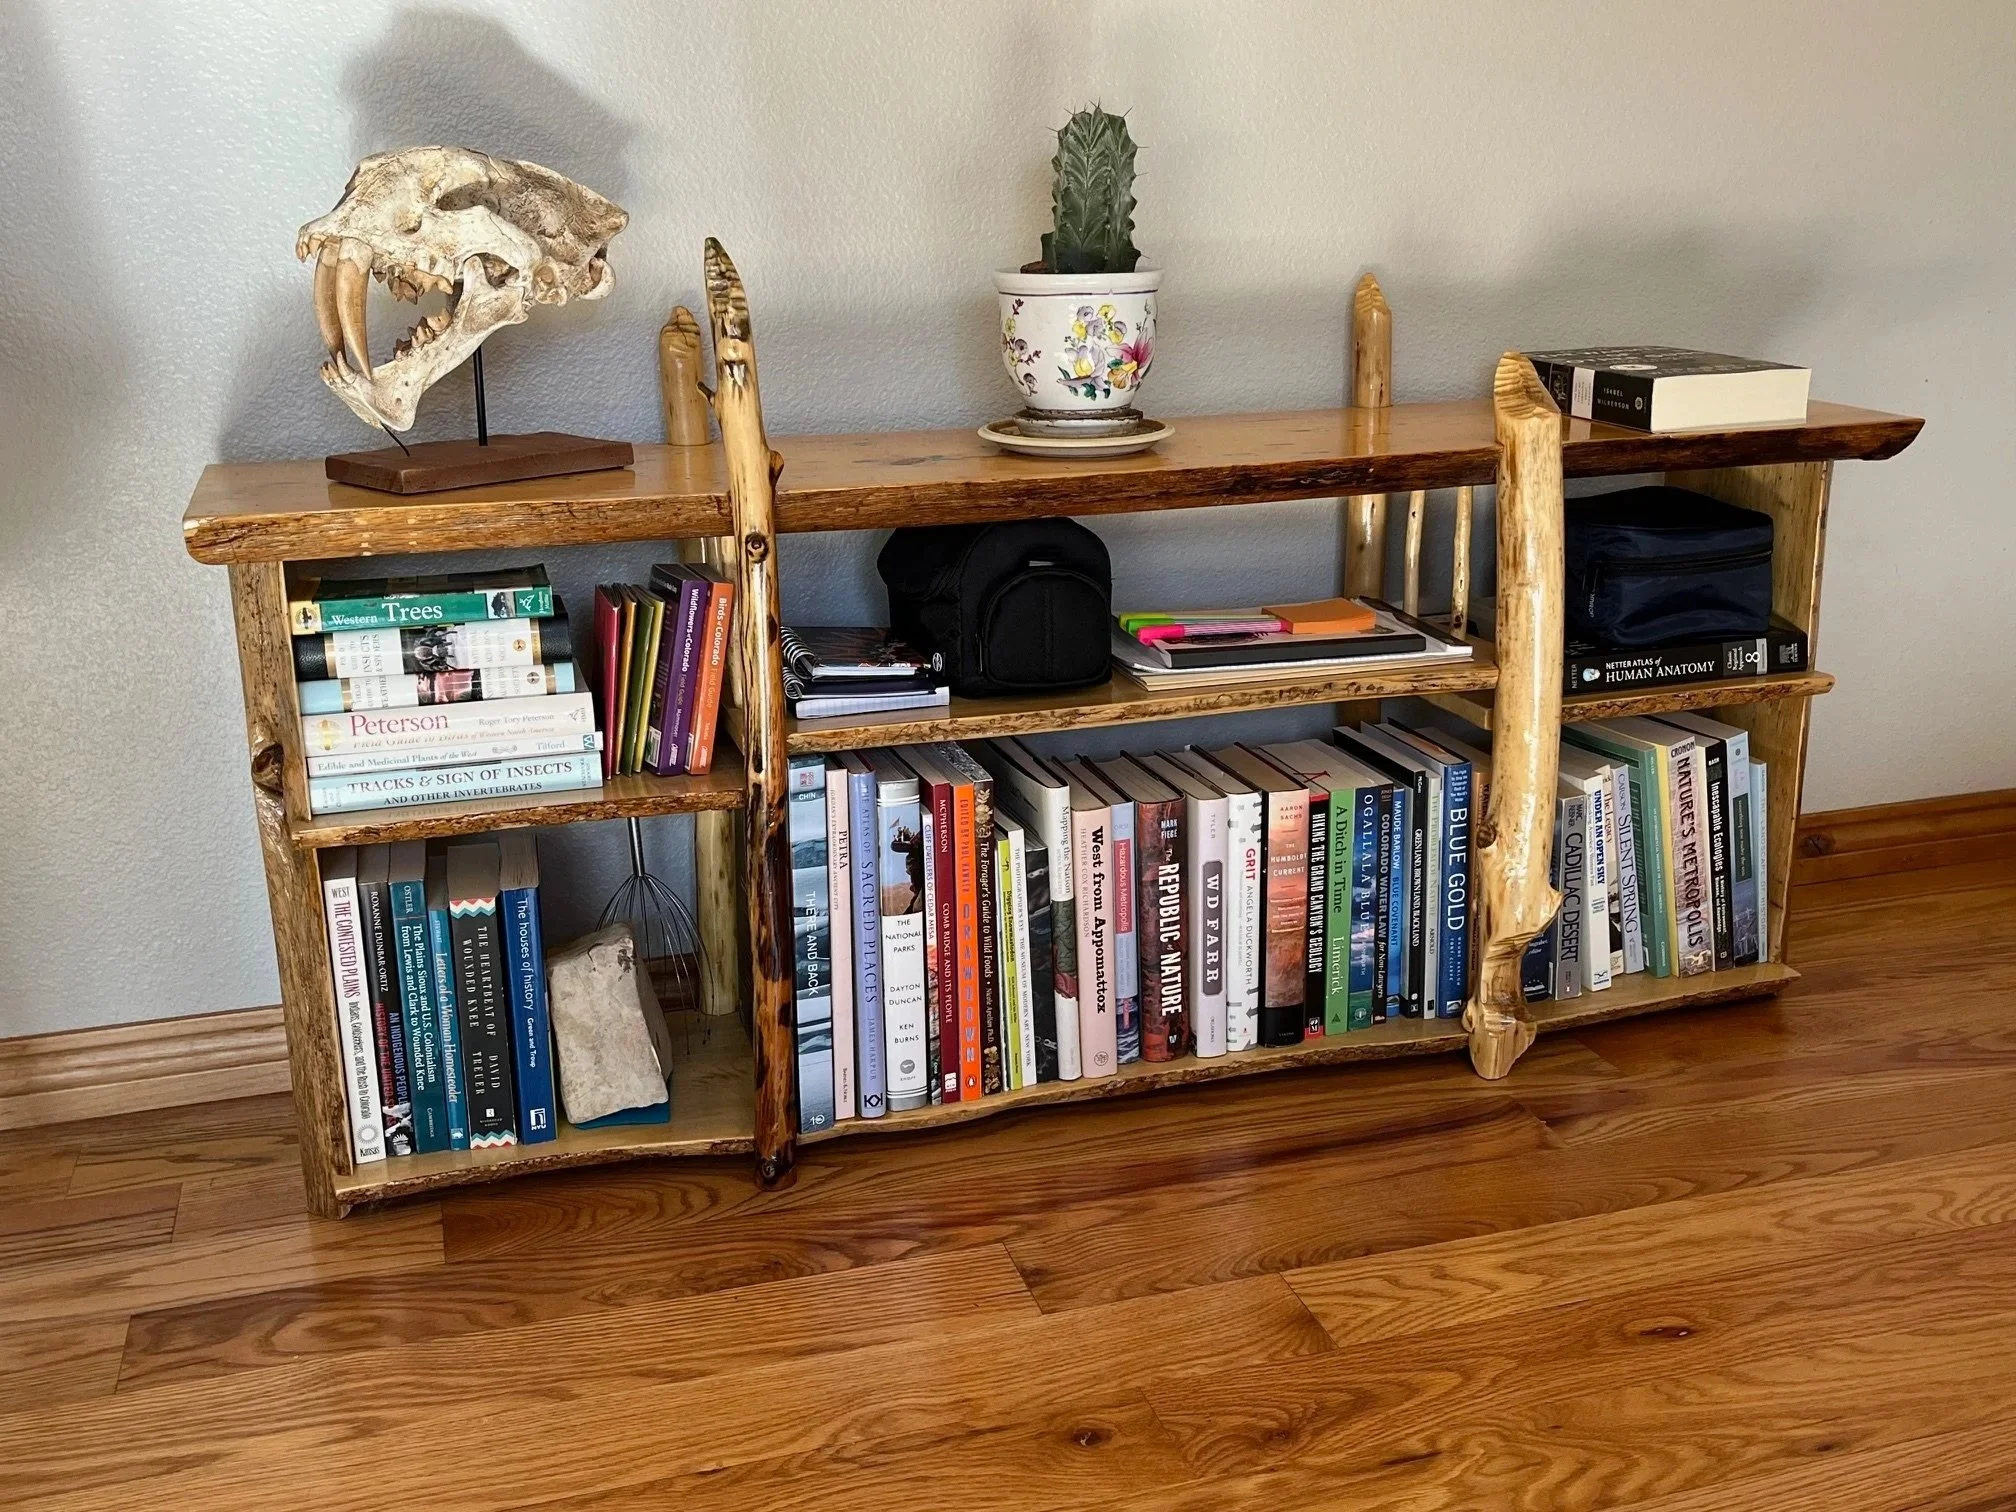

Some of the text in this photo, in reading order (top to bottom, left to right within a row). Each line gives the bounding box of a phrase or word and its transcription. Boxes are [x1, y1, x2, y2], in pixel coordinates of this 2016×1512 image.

[331, 602, 443, 626] Western Trees
[1605, 657, 1654, 670] NETTER ATLAS
[1605, 660, 1715, 683] HUMAN ANATOMY
[350, 714, 450, 737] Peterson
[317, 754, 439, 772] Edible and Medicinal Plants
[1670, 741, 1696, 758] CRONON
[347, 775, 416, 794] TRACKS
[419, 773, 434, 788] &
[436, 769, 475, 786] SIGN
[480, 766, 501, 781] OF
[507, 761, 573, 780] INSECTS
[383, 782, 543, 806] AND OTHER INVERTEBRATES
[1618, 773, 1627, 811] CARSON
[1060, 806, 1069, 845] Mapping
[1393, 801, 1401, 832] MAUDE
[1575, 804, 1583, 820] MARC
[1604, 793, 1613, 843] The Legacy
[1711, 782, 1724, 872] Inescapable Ecologies
[839, 830, 848, 870] PETRA
[1392, 835, 1400, 869] BARLOW
[1448, 808, 1468, 866] BLUE
[1594, 790, 1605, 884] UNDER AN OPEN SKY
[1619, 814, 1635, 872] SILENT
[1676, 757, 1704, 949] NATURE'S METROPOLIS
[925, 845, 933, 881] DWELLERS
[1246, 848, 1256, 880] GRIT
[1271, 853, 1307, 862] HUMBOLDT
[1273, 867, 1305, 876] CURRENT
[1360, 794, 1374, 931] OGALLALA BLUE
[331, 886, 350, 898] WEST
[403, 886, 414, 913] OSTLER
[861, 808, 877, 1003] ATLAS OF SACRED PLACES
[926, 882, 934, 892] OF
[1158, 863, 1181, 943] REPUBLIC
[1246, 885, 1254, 923] ANGELA
[1309, 813, 1326, 973] HIKING THE GRAND CANYON'S GEOLOGY
[1331, 806, 1348, 995] A Ditch in Time Limerick
[1374, 814, 1390, 998] COLORADO WATER LAW for Non-Lawyers
[1447, 873, 1466, 931] GOLD
[1561, 832, 1583, 962] CADILLAC DESERT
[1621, 874, 1638, 934] SPRING
[897, 918, 911, 926] THE
[942, 903, 950, 929] COMB
[980, 842, 994, 1005] The Forager's Guide to Wild Foods Nicole
[1092, 826, 1108, 1014] West from Appomattox
[1120, 888, 1128, 932] Metropolis
[1391, 901, 1399, 946] COVENANT
[334, 901, 361, 998] THE CONTESTED PLAINS
[517, 898, 536, 1010] The houses of history
[805, 891, 819, 996] THERE AND BACK
[885, 930, 921, 940] NATIONAL
[893, 944, 916, 953] PARKS
[943, 931, 951, 956] RIDGE
[463, 939, 480, 1028] WOUNDED KNEE
[478, 926, 496, 1036] THE HEARTBEAT OF
[890, 983, 921, 992] DAYTON
[1160, 952, 1182, 1016] NATURE
[402, 926, 425, 1091] from Lewis and Clark to Wounded Knee
[414, 942, 436, 1083] Plains Sioux and Colonialism
[889, 996, 922, 1005] DUNCAN
[945, 995, 953, 1023] PEOPLE
[527, 1018, 535, 1036] Green
[894, 1035, 919, 1044] BURNS
[868, 1018, 877, 1081] JAMES HARPUR
[472, 1051, 485, 1095] TREUER
[489, 1055, 500, 1088] DAVID
